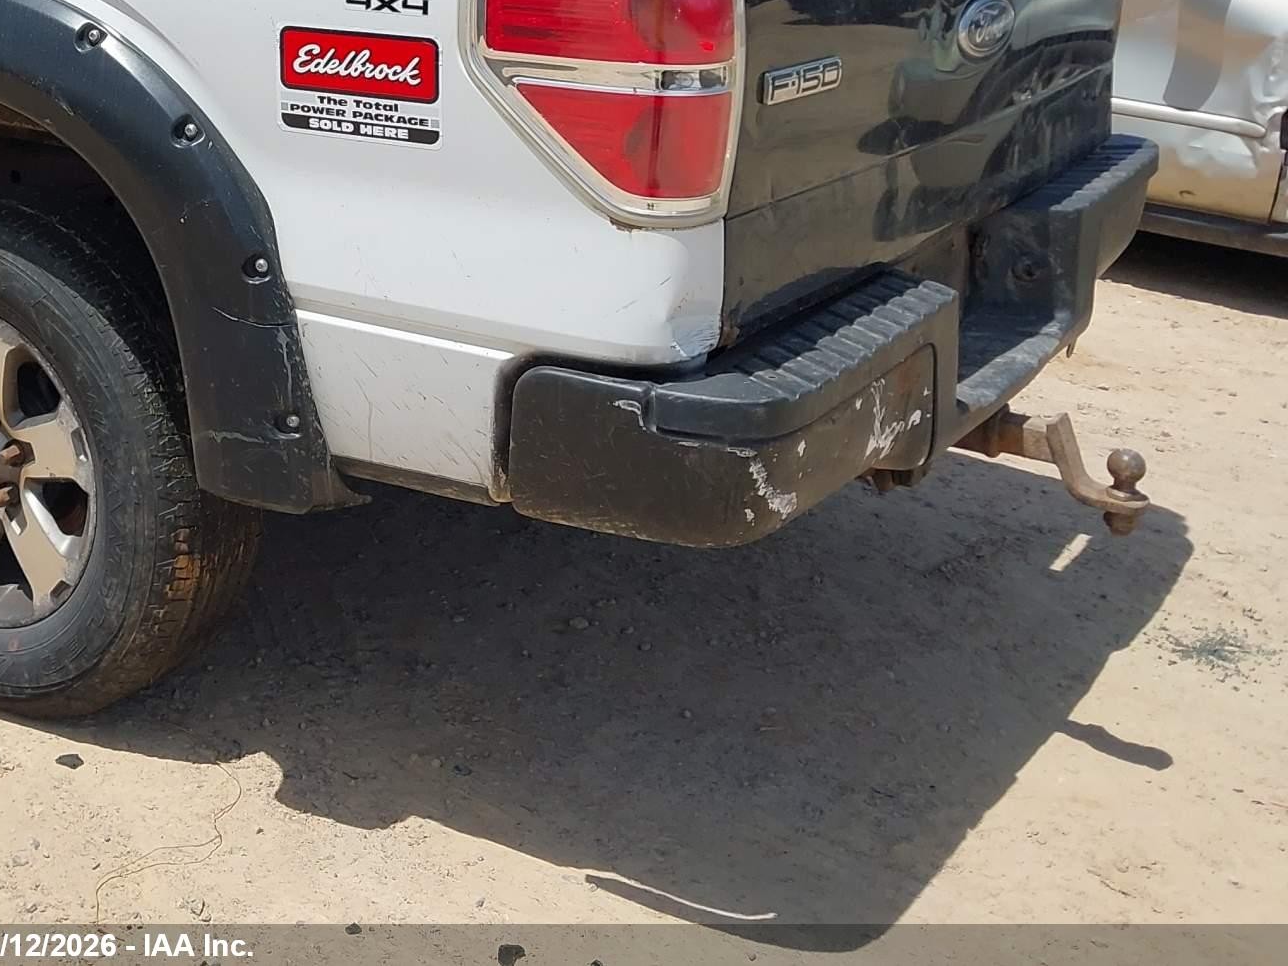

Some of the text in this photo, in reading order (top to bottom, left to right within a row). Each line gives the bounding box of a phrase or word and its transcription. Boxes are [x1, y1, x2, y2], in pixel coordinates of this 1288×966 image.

[292, 43, 422, 86] Edelbrock
[770, 60, 841, 101] F-150
[290, 104, 429, 127] POWER PACKAGE
[317, 95, 399, 113] The Total
[308, 117, 409, 139] SOLD HERE
